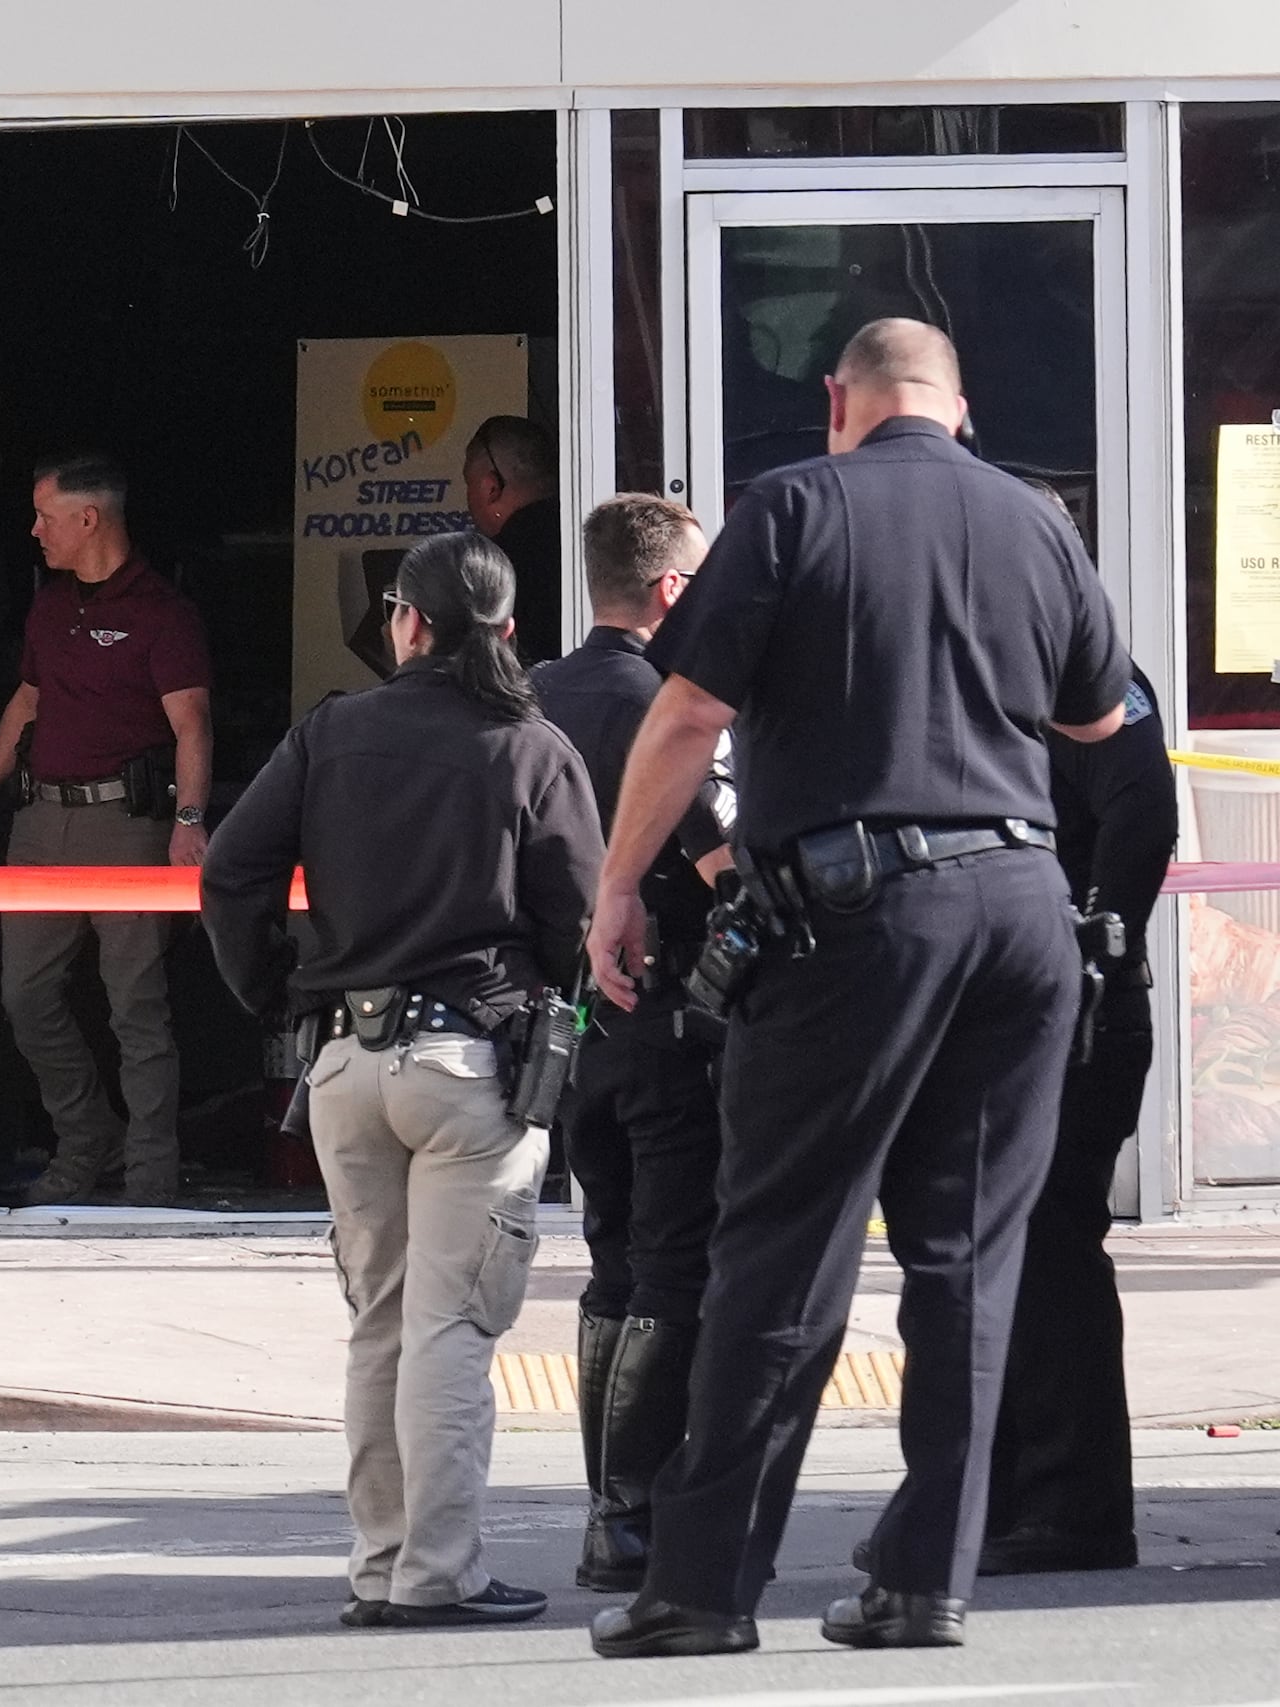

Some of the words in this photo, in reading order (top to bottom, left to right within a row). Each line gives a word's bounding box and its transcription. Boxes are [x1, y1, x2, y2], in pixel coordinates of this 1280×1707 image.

[303, 430, 423, 491] Korean
[356, 478, 452, 504] STREET
[1241, 557, 1265, 569] USO
